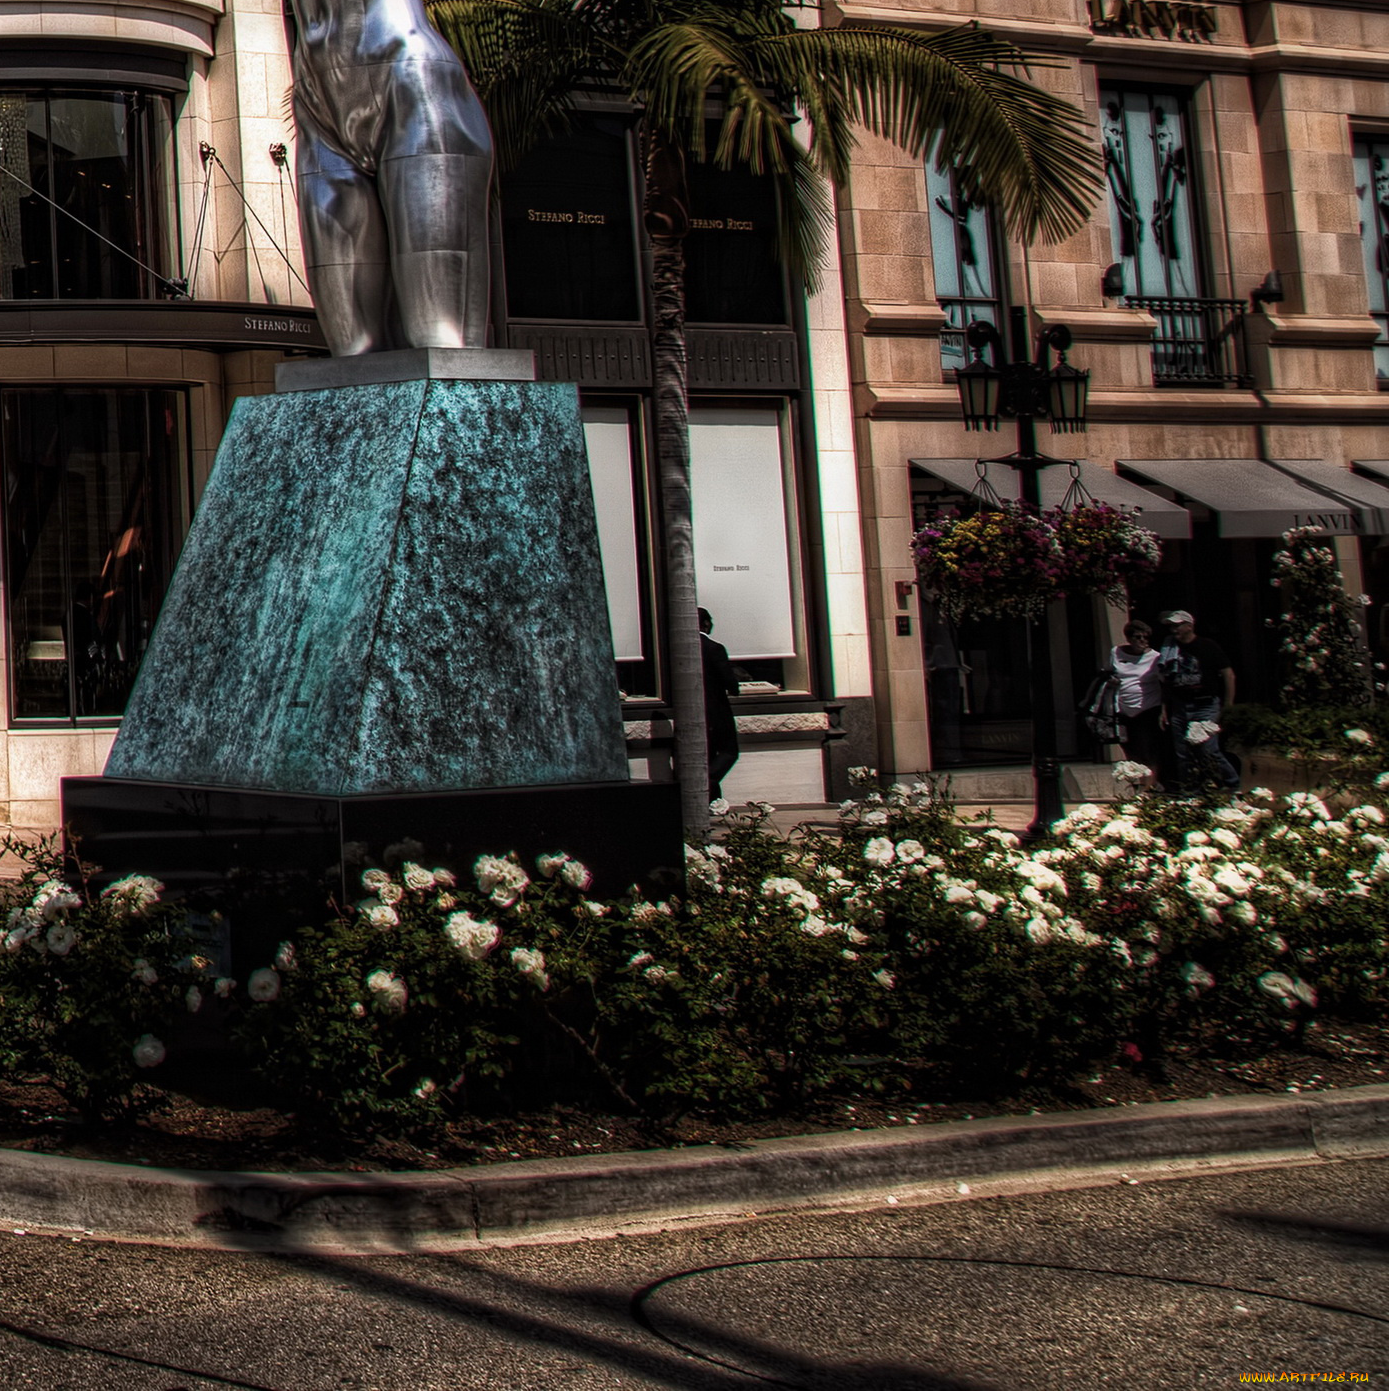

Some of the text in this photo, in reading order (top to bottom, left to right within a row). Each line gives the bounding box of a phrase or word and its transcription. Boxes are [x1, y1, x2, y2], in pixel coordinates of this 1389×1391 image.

[528, 209, 605, 224] STEFANO RICCI
[726, 218, 753, 231] RICCI
[244, 317, 311, 334] STEFANO RICCI
[1294, 514, 1361, 529] LANVIN
